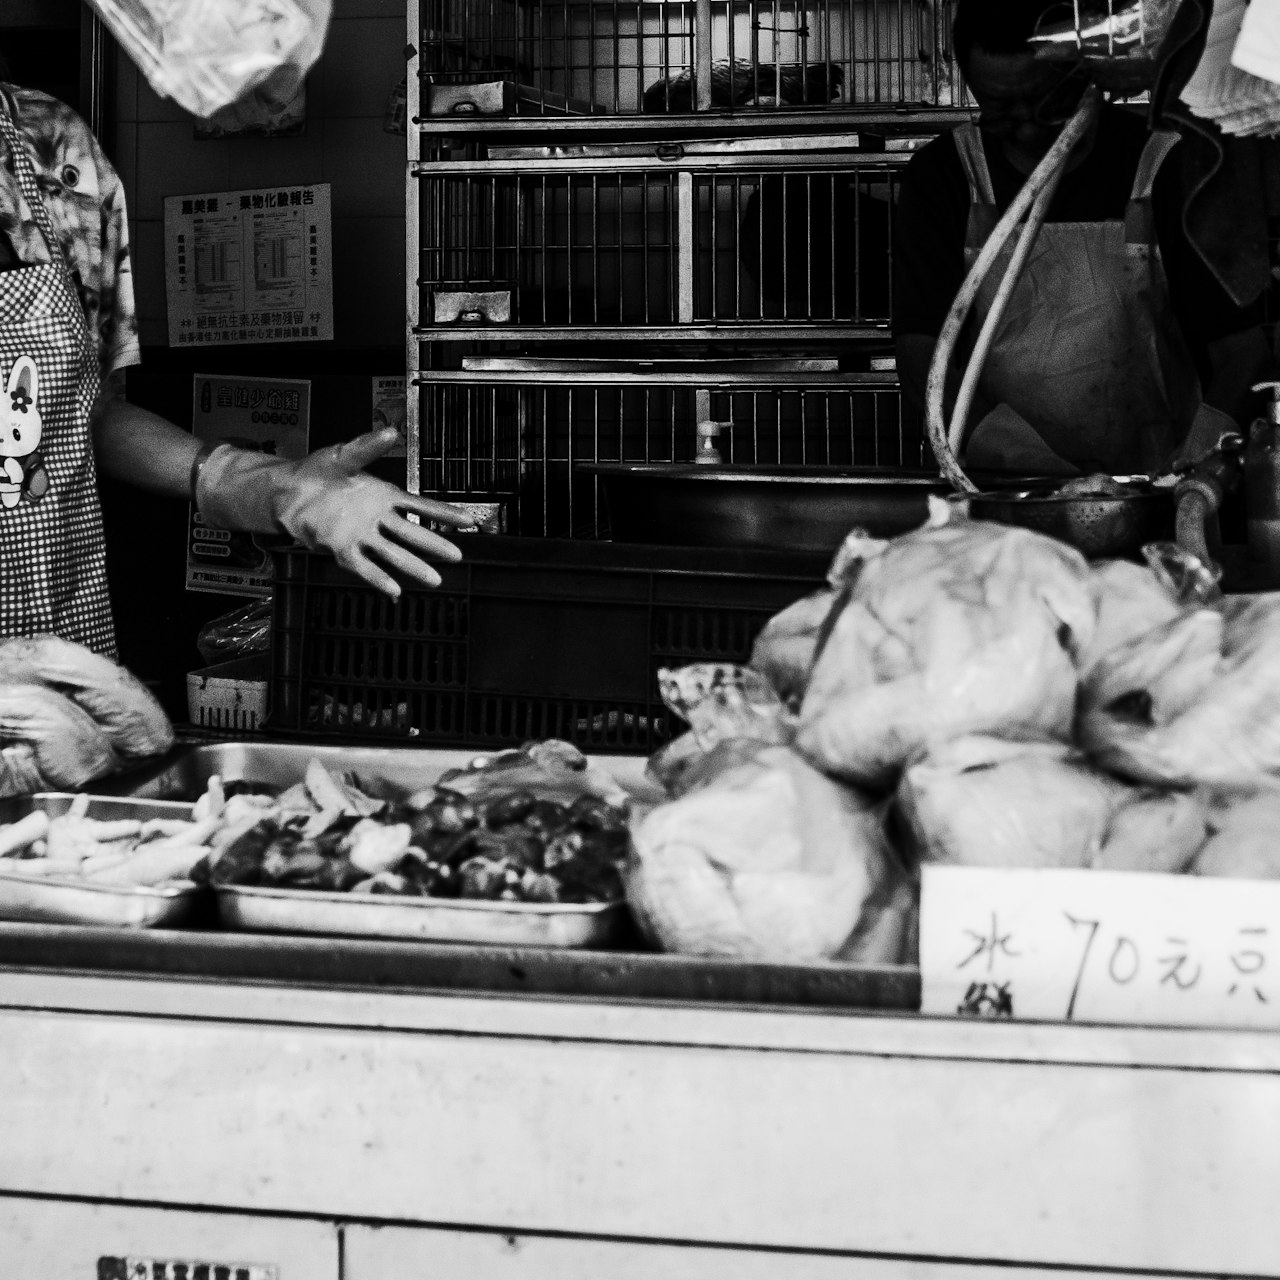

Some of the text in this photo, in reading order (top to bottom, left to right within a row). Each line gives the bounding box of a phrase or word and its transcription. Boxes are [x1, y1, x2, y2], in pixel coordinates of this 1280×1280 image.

[239, 190, 315, 211] 藥物化驗報告
